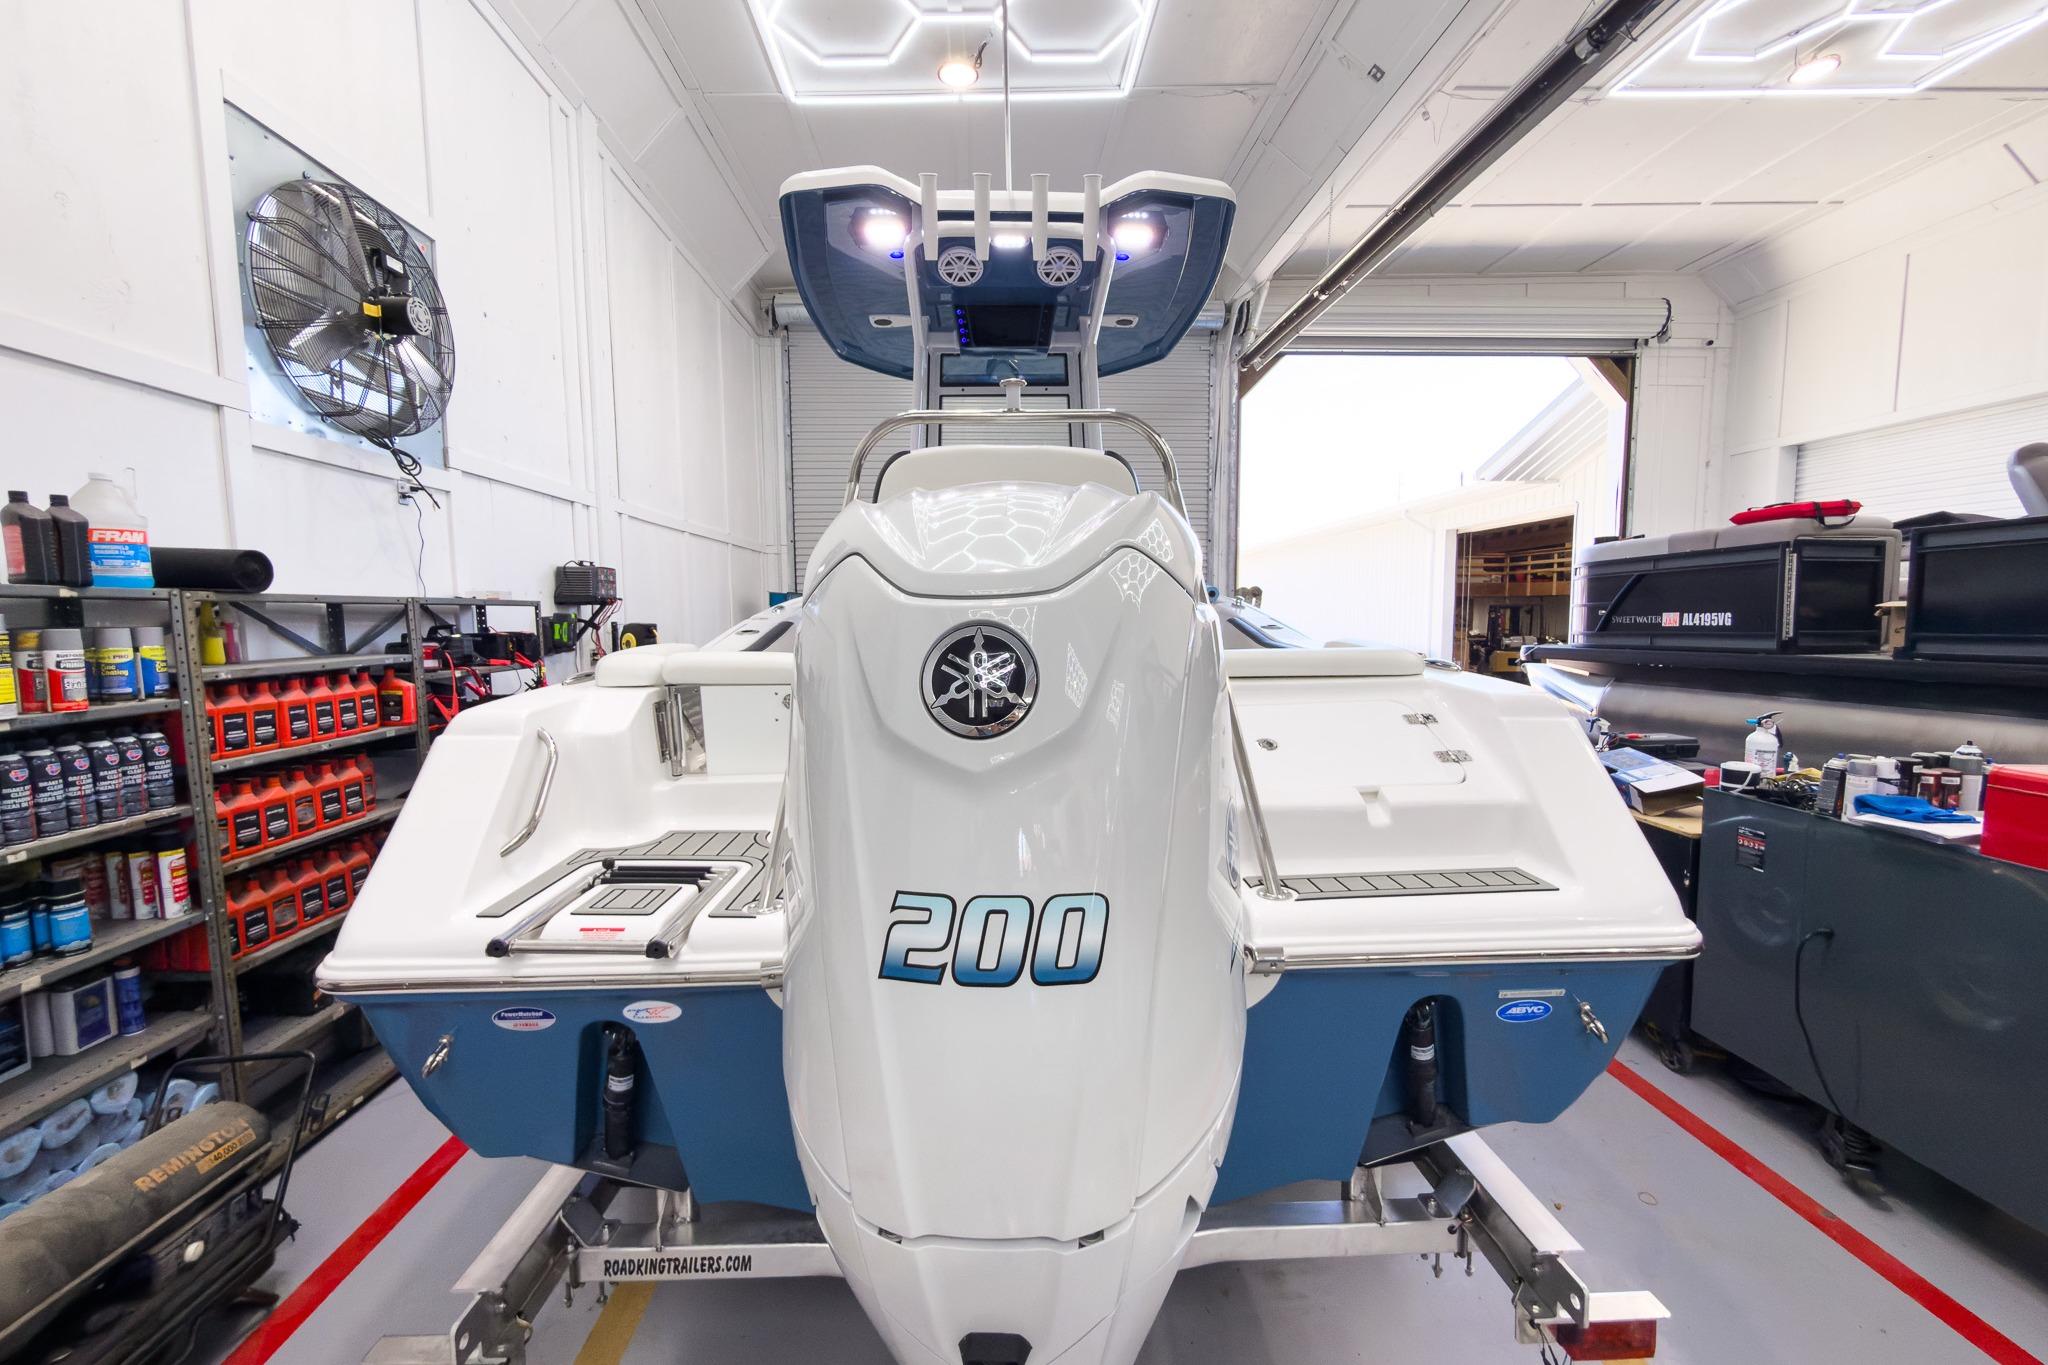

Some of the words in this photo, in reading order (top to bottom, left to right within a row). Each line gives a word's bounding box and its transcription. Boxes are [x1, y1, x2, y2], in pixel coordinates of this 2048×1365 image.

[91, 529, 145, 543] FRAM
[1611, 614, 1662, 624] SWEETWATER
[1682, 612, 1732, 626] AL4195VG
[878, 890, 1110, 987] 200
[1504, 1005, 1545, 1015] ABYC
[603, 1254, 752, 1278] ROADKINGTRAILERS.COM
